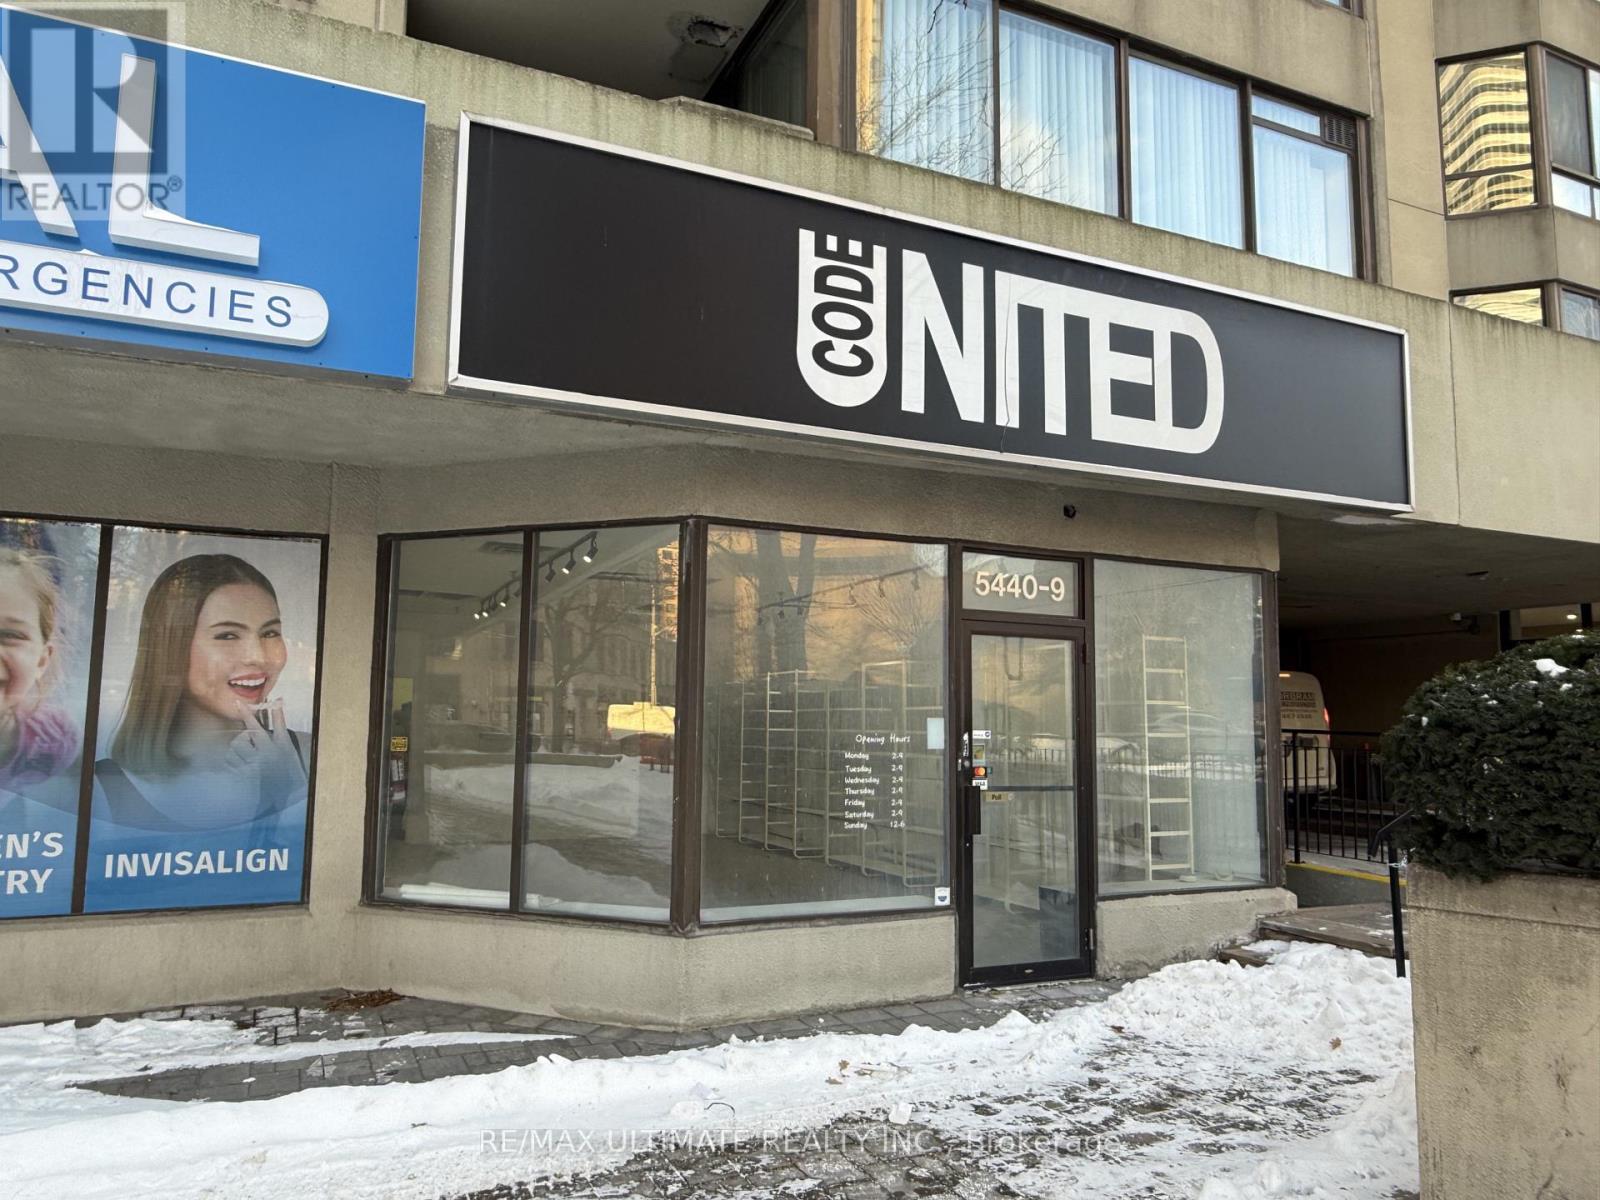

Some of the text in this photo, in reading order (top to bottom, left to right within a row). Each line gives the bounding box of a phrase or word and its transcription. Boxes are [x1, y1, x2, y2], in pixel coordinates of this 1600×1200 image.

[811, 230, 874, 378] CODE
[975, 571, 1065, 602] 5440-9
[855, 732, 911, 745] Opening Hours
[844, 752, 869, 760] Monday
[845, 765, 872, 774] Tuesday
[844, 777, 880, 785] Wednesday
[845, 787, 875, 796] Thursday
[844, 799, 865, 808] Friday
[844, 810, 875, 819] Saturday
[844, 821, 868, 830] Sunday
[0, 831, 64, 859] N'S
[104, 848, 290, 879] INVISALIGN
[0, 868, 54, 895] RY
